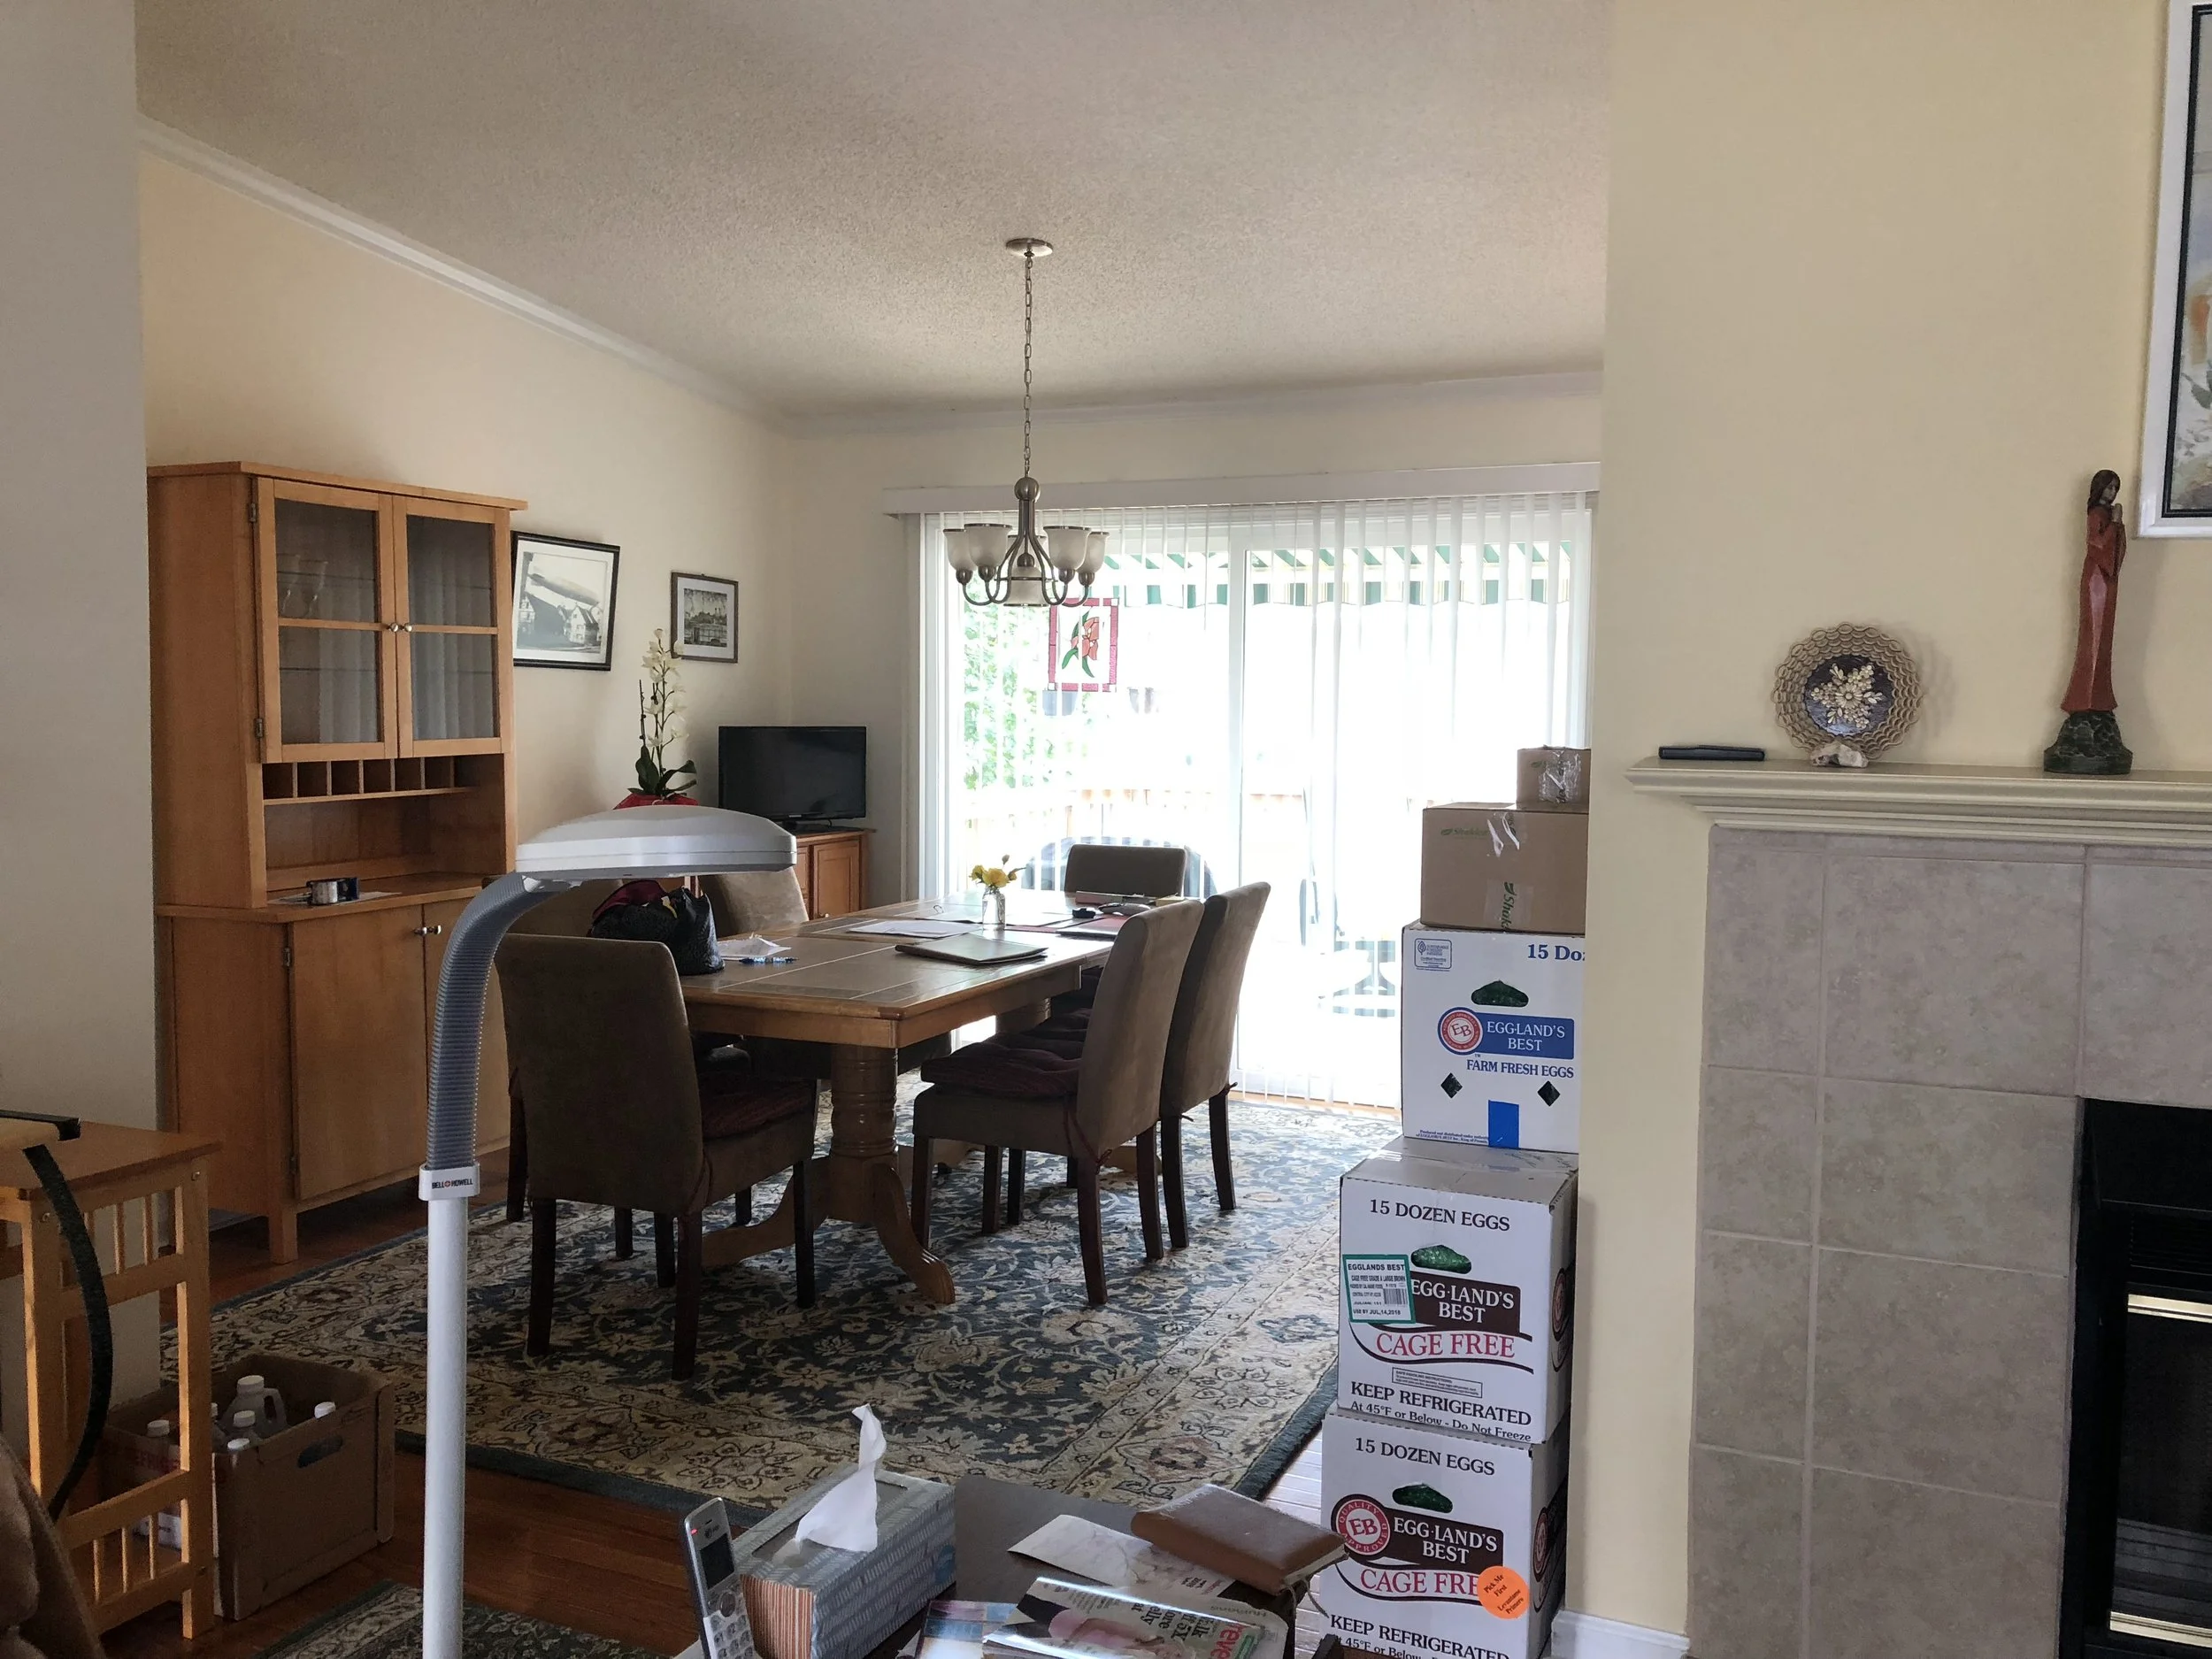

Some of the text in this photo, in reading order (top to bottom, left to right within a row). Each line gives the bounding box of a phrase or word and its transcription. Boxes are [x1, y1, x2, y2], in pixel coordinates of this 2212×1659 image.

[1502, 895, 1516, 929] Shak
[1527, 944, 1548, 959] 15
[1508, 1039, 1542, 1051] BEST
[1466, 1060, 1574, 1078] FARM FRESH EGGS
[1371, 1199, 1509, 1231] 15 DOZEN EGGS
[1439, 1302, 1486, 1323] BEST
[1377, 1333, 1515, 1357] CAGE FREE
[1351, 1382, 1395, 1402] KEEP
[1400, 1390, 1531, 1425] REFRIGERATED
[1351, 1402, 1363, 1411] At
[1394, 1409, 1407, 1419] or
[1409, 1407, 1442, 1425] Below
[1452, 1419, 1468, 1430] Do
[1471, 1425, 1492, 1435] Not
[1495, 1428, 1531, 1442] Freeze
[1356, 1438, 1495, 1475] 15 DOZEN EGGS
[1340, 1502, 1379, 1524] QUALITY
[1423, 1541, 1469, 1563] BEST
[1361, 1570, 1479, 1596] CAGE FRE
[1494, 1585, 1508, 1597] First
[1330, 1615, 1374, 1636] KEEP
[1373, 1646, 1386, 1655] or
